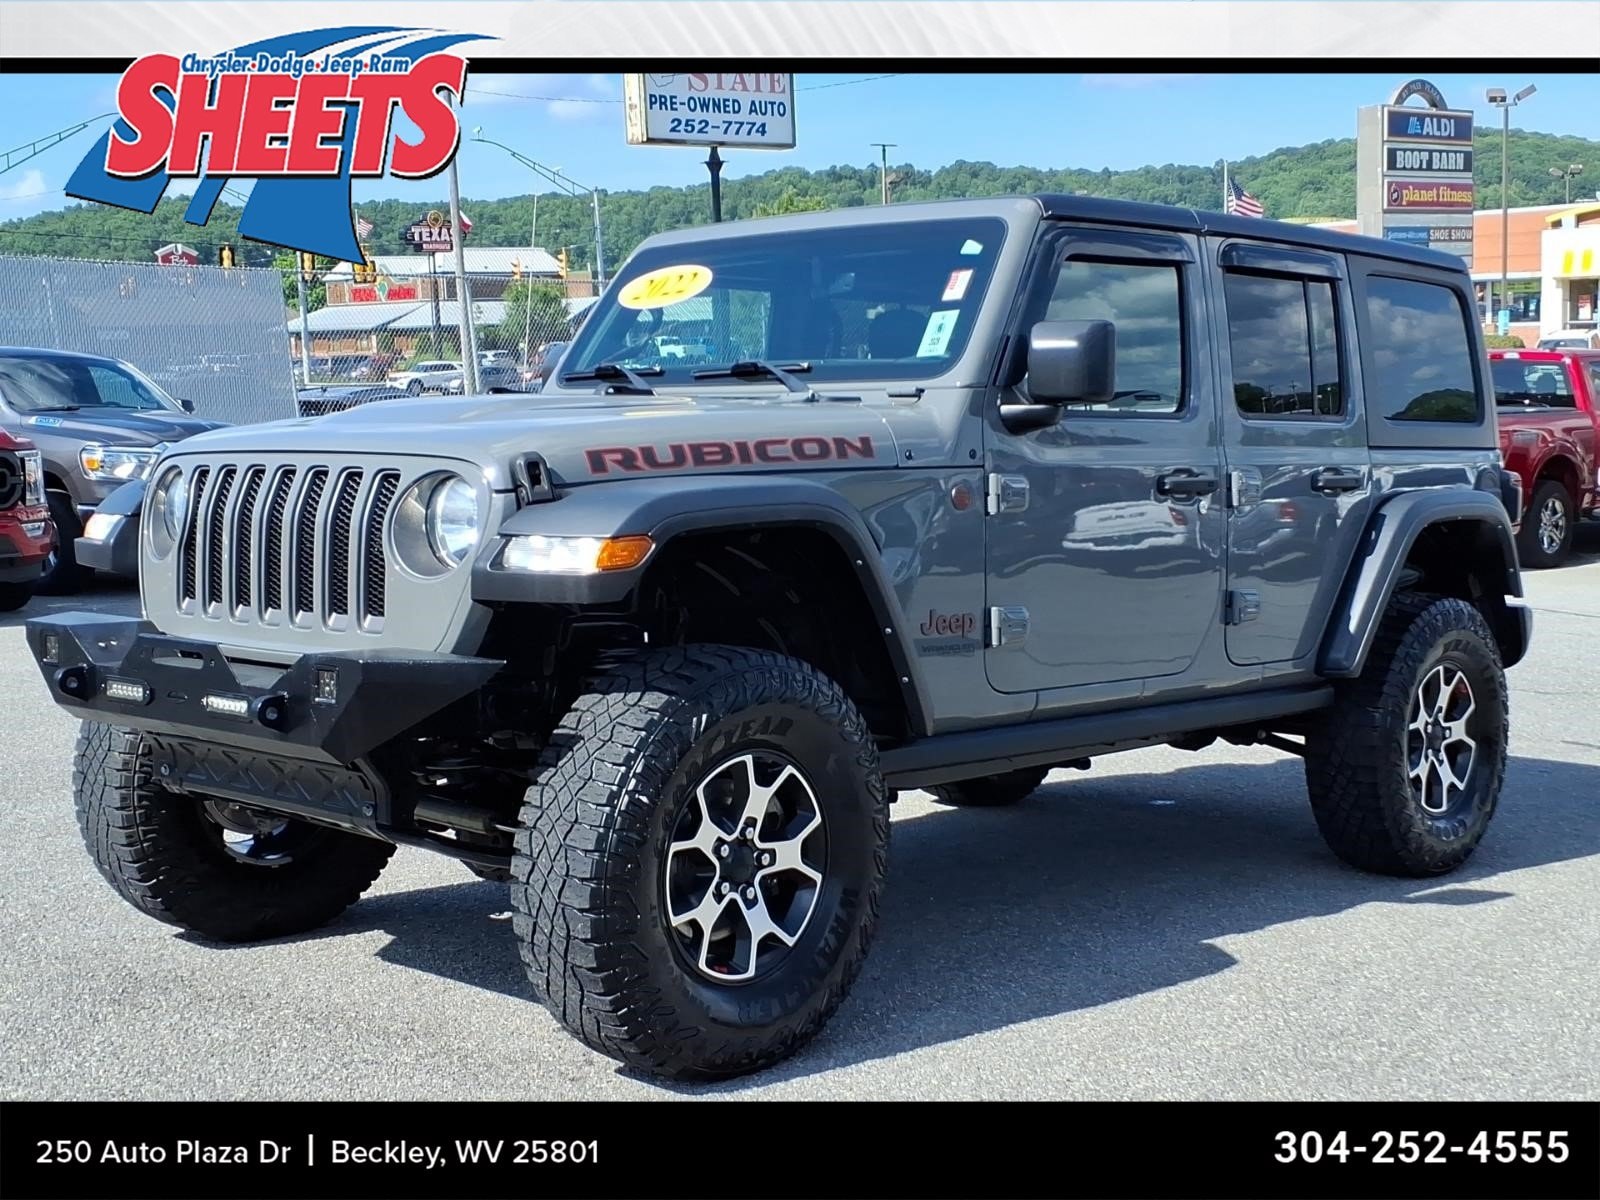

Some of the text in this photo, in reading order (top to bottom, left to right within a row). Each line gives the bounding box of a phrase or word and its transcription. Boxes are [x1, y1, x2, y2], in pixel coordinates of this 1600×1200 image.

[649, 94, 787, 117] PRE-OWNED AUTO
[669, 118, 768, 136] 252-7774
[1422, 117, 1455, 137] ALDI
[1396, 151, 1464, 170] BOOT BARN
[1402, 185, 1473, 206] planet fitness
[1429, 228, 1450, 241] SHOE
[1451, 228, 1473, 241] SHOW
[584, 435, 876, 475] RUBICON
[920, 608, 976, 638] Jeep
